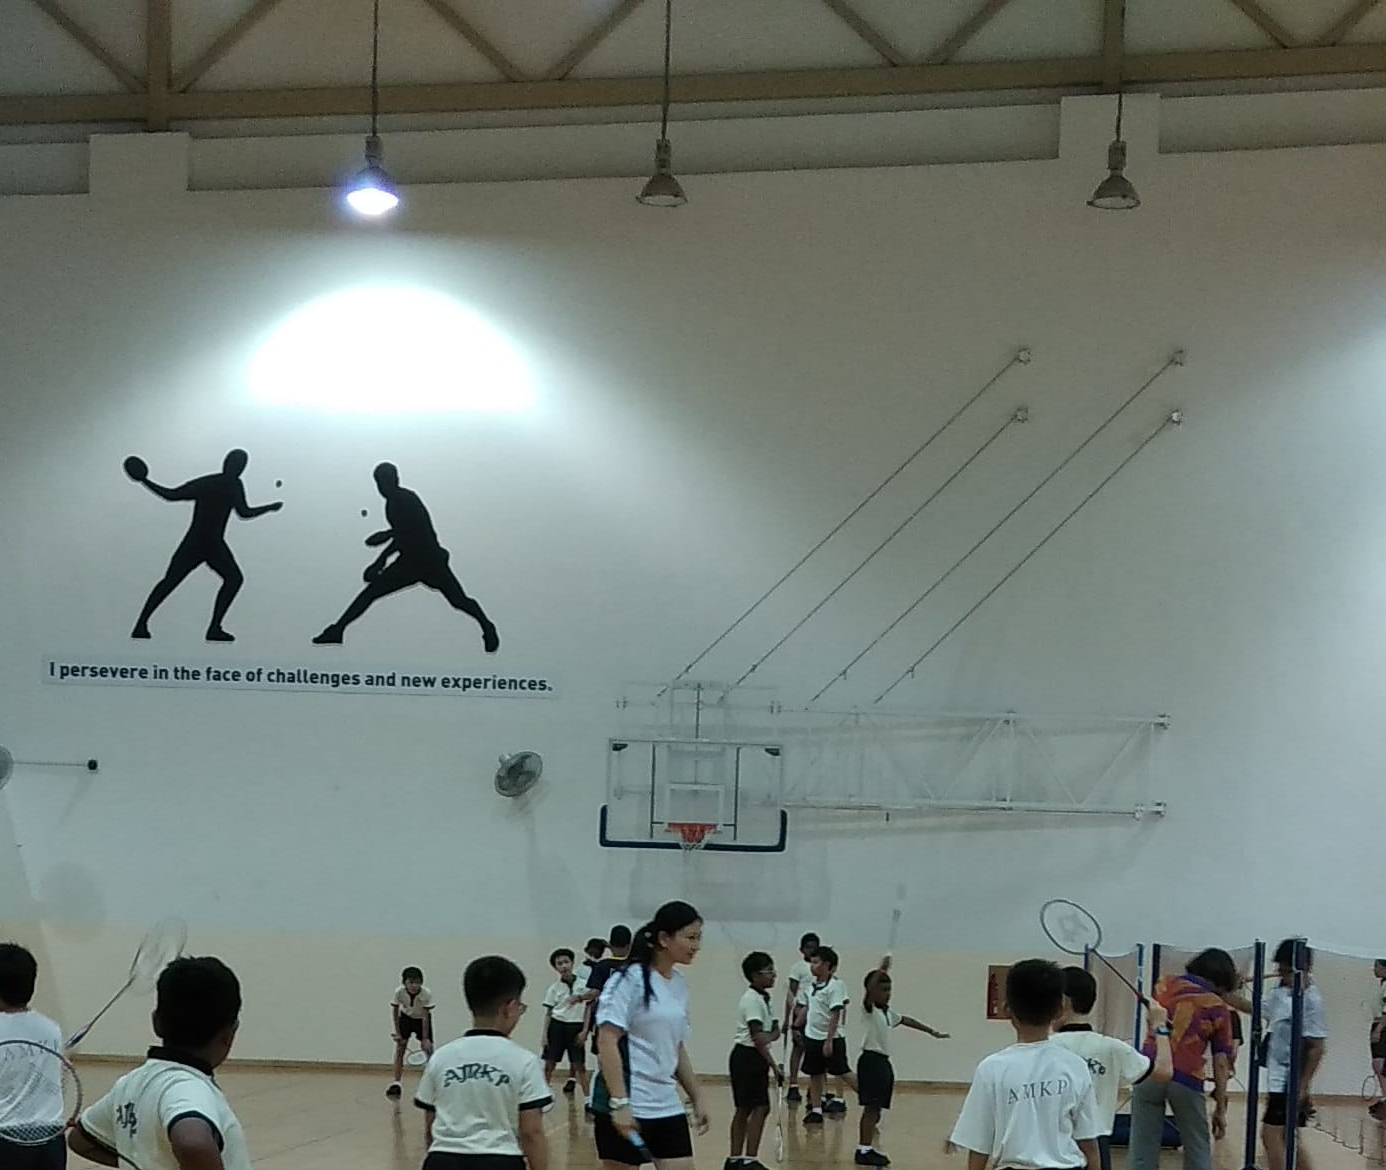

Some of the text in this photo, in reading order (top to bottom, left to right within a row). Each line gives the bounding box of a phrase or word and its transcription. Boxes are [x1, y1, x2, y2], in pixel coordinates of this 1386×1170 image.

[49, 661, 553, 692] I persevere in the face of challenges and new experiences.
[1007, 1079, 1069, 1105] AMKP
